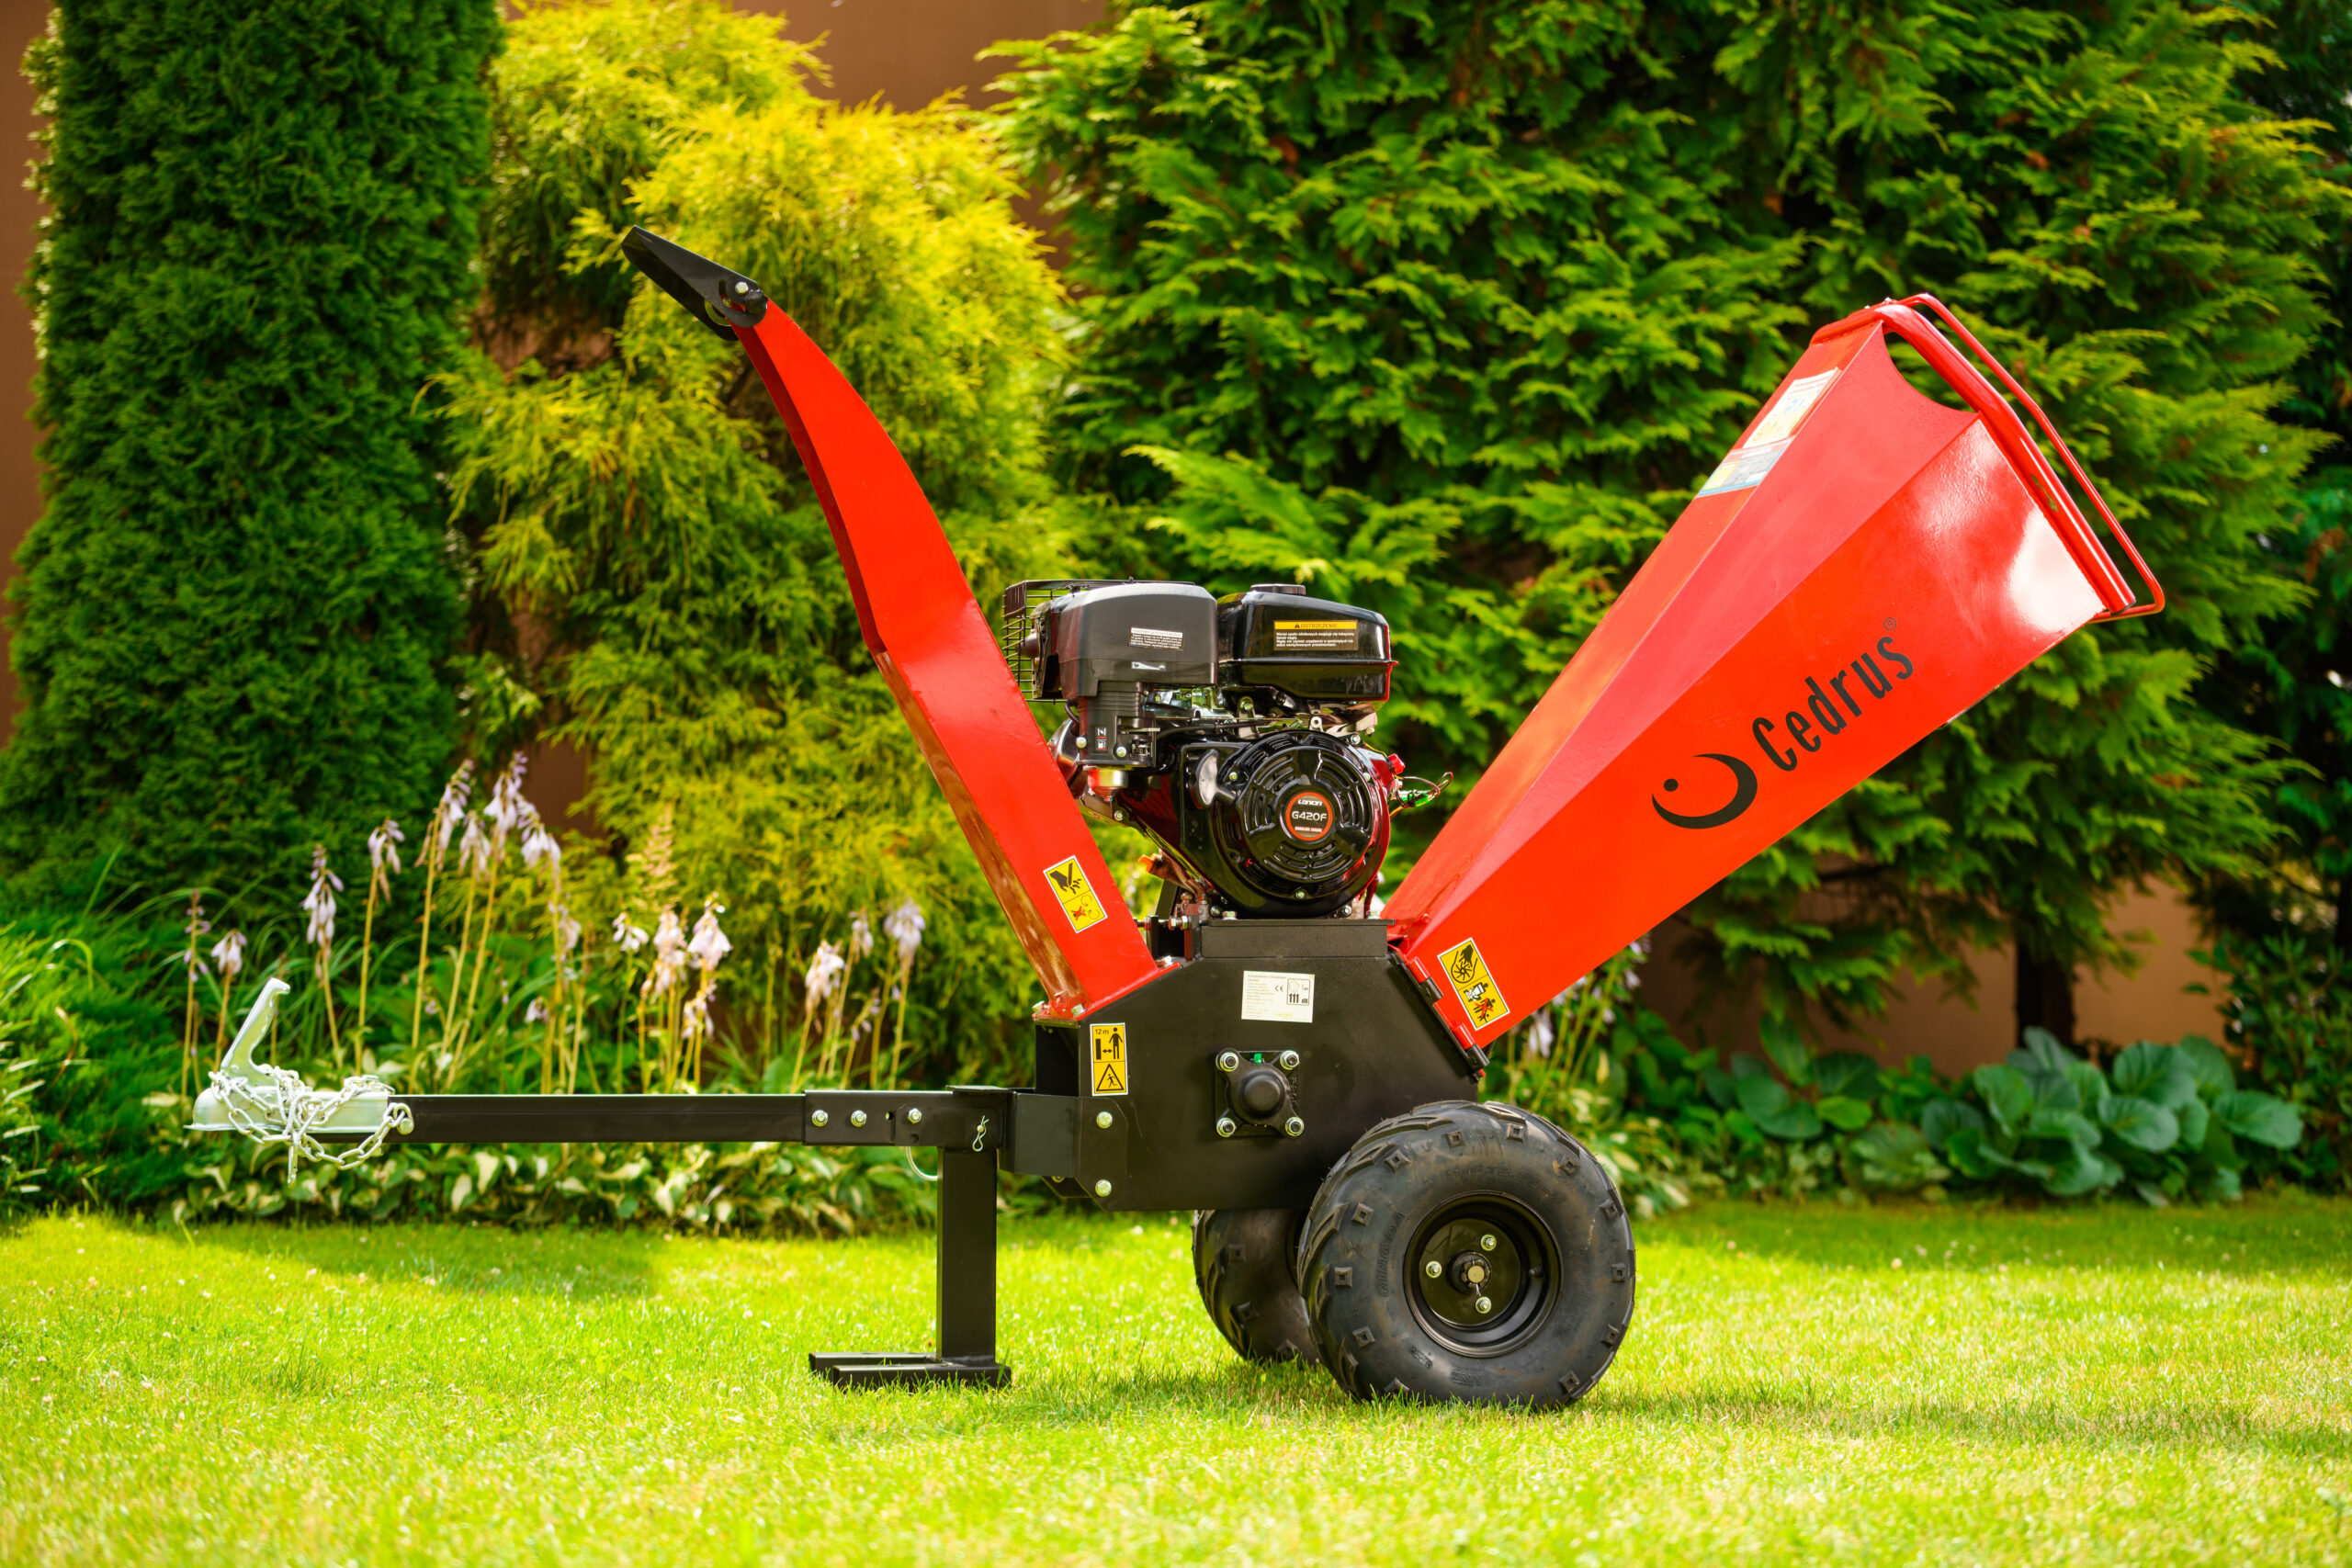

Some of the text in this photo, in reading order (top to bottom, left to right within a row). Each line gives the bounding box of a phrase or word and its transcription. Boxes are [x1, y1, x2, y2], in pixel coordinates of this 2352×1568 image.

[1752, 636, 1914, 772] Cedrus
[1292, 810, 1328, 821] G420F
[1288, 993, 1299, 1003] 111
